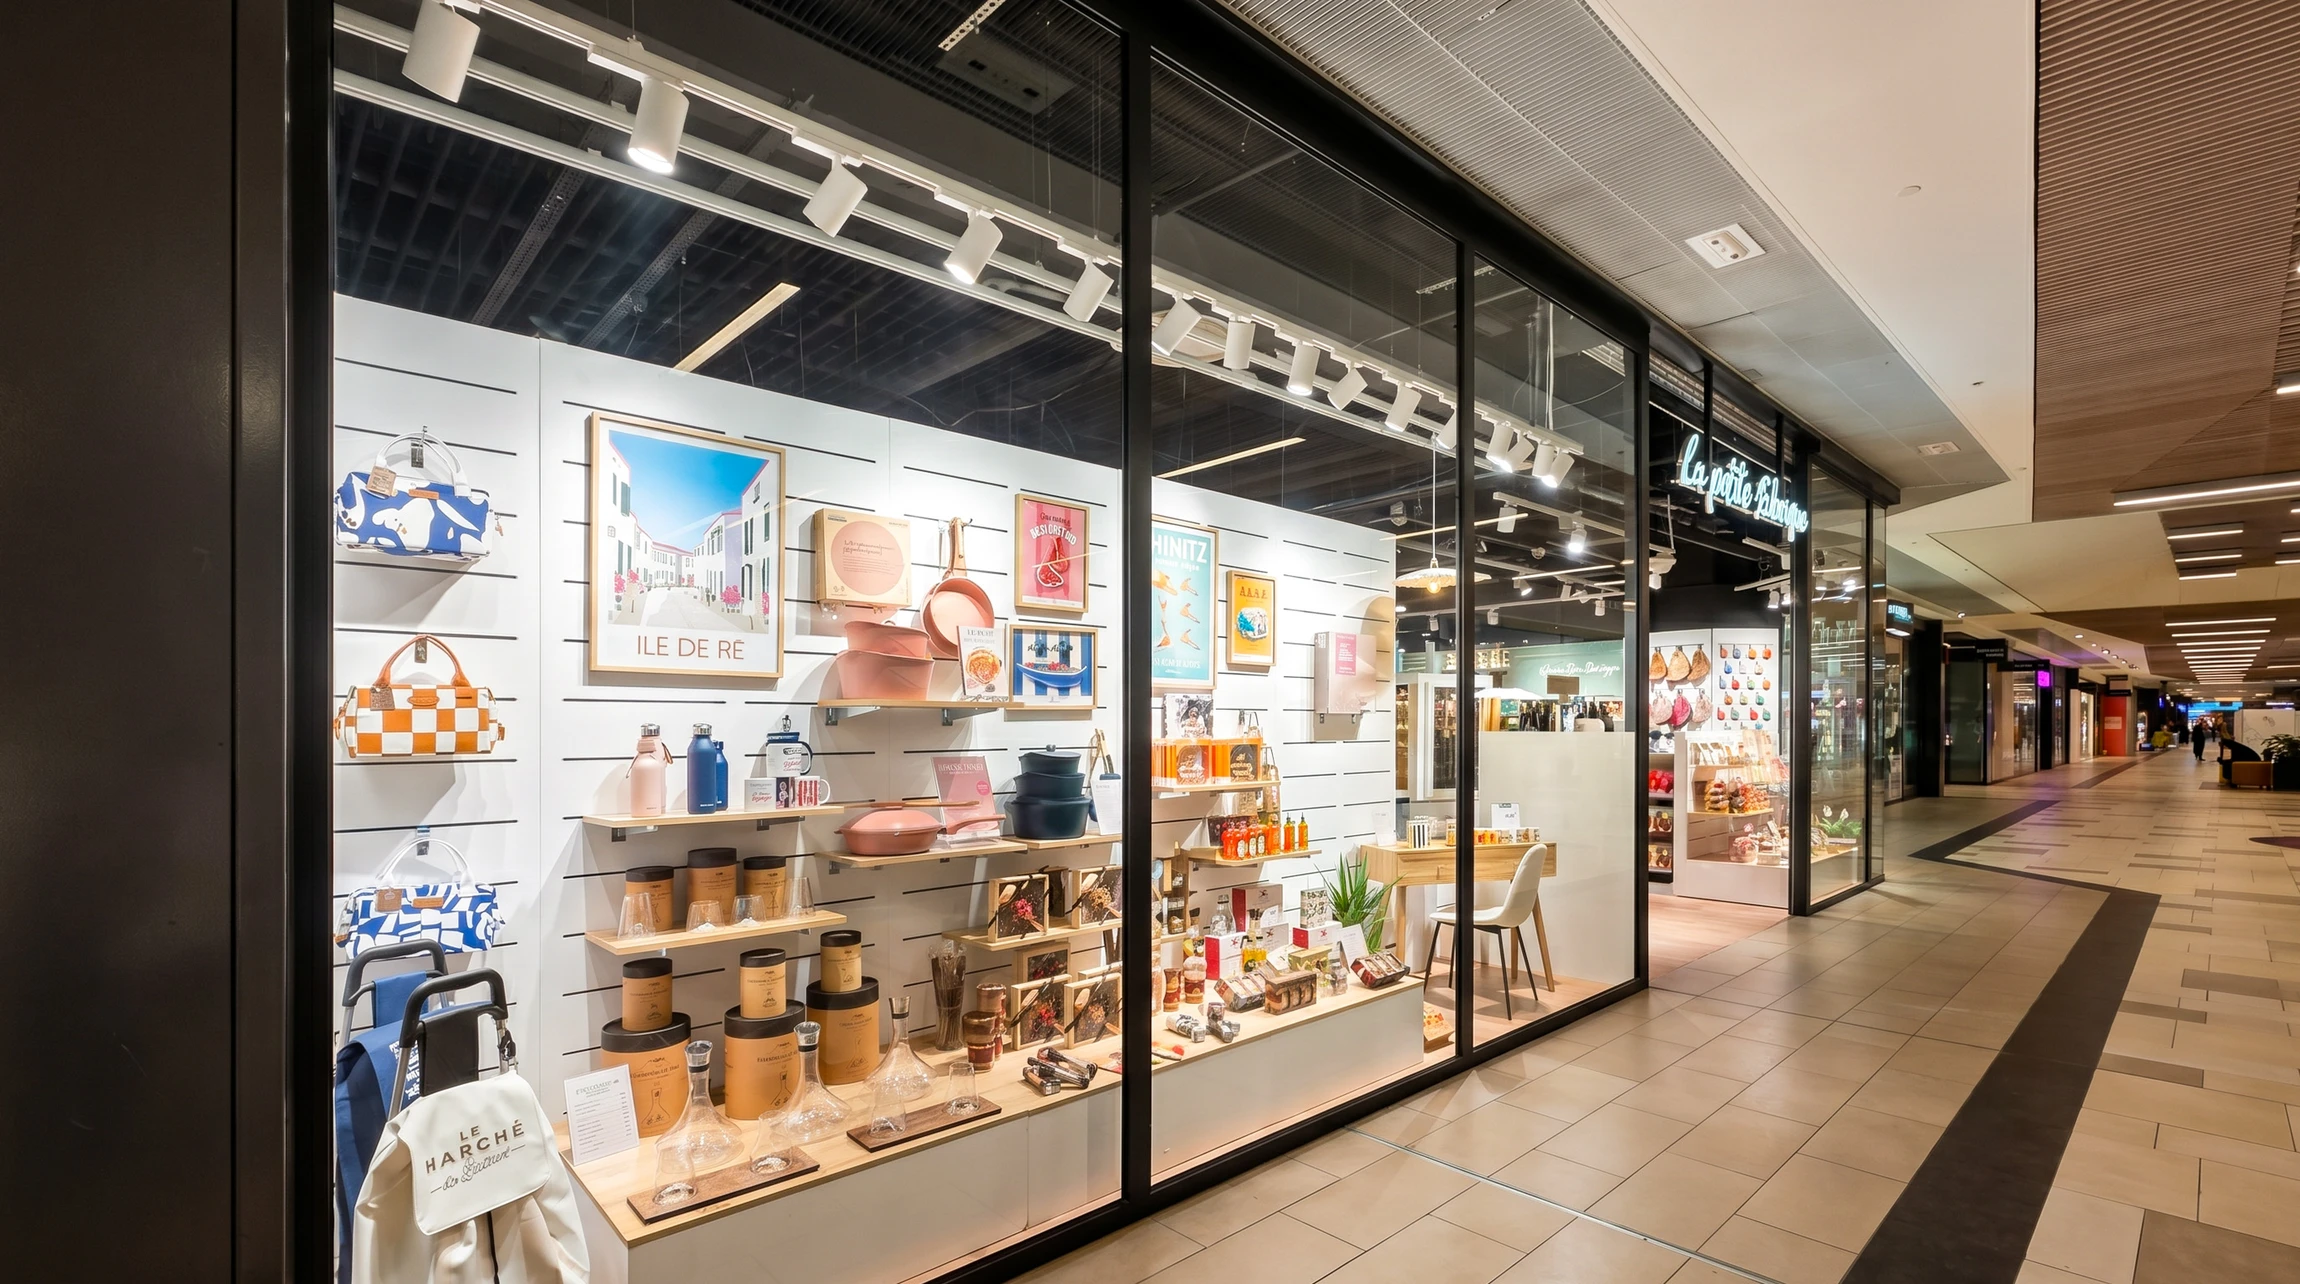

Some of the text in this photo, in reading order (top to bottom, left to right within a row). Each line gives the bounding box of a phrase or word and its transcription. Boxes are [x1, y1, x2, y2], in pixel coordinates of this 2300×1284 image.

[637, 635, 669, 656] ILE
[678, 637, 709, 658] DE
[459, 1125, 481, 1142] LE
[425, 1119, 525, 1175] HARCHÉ
